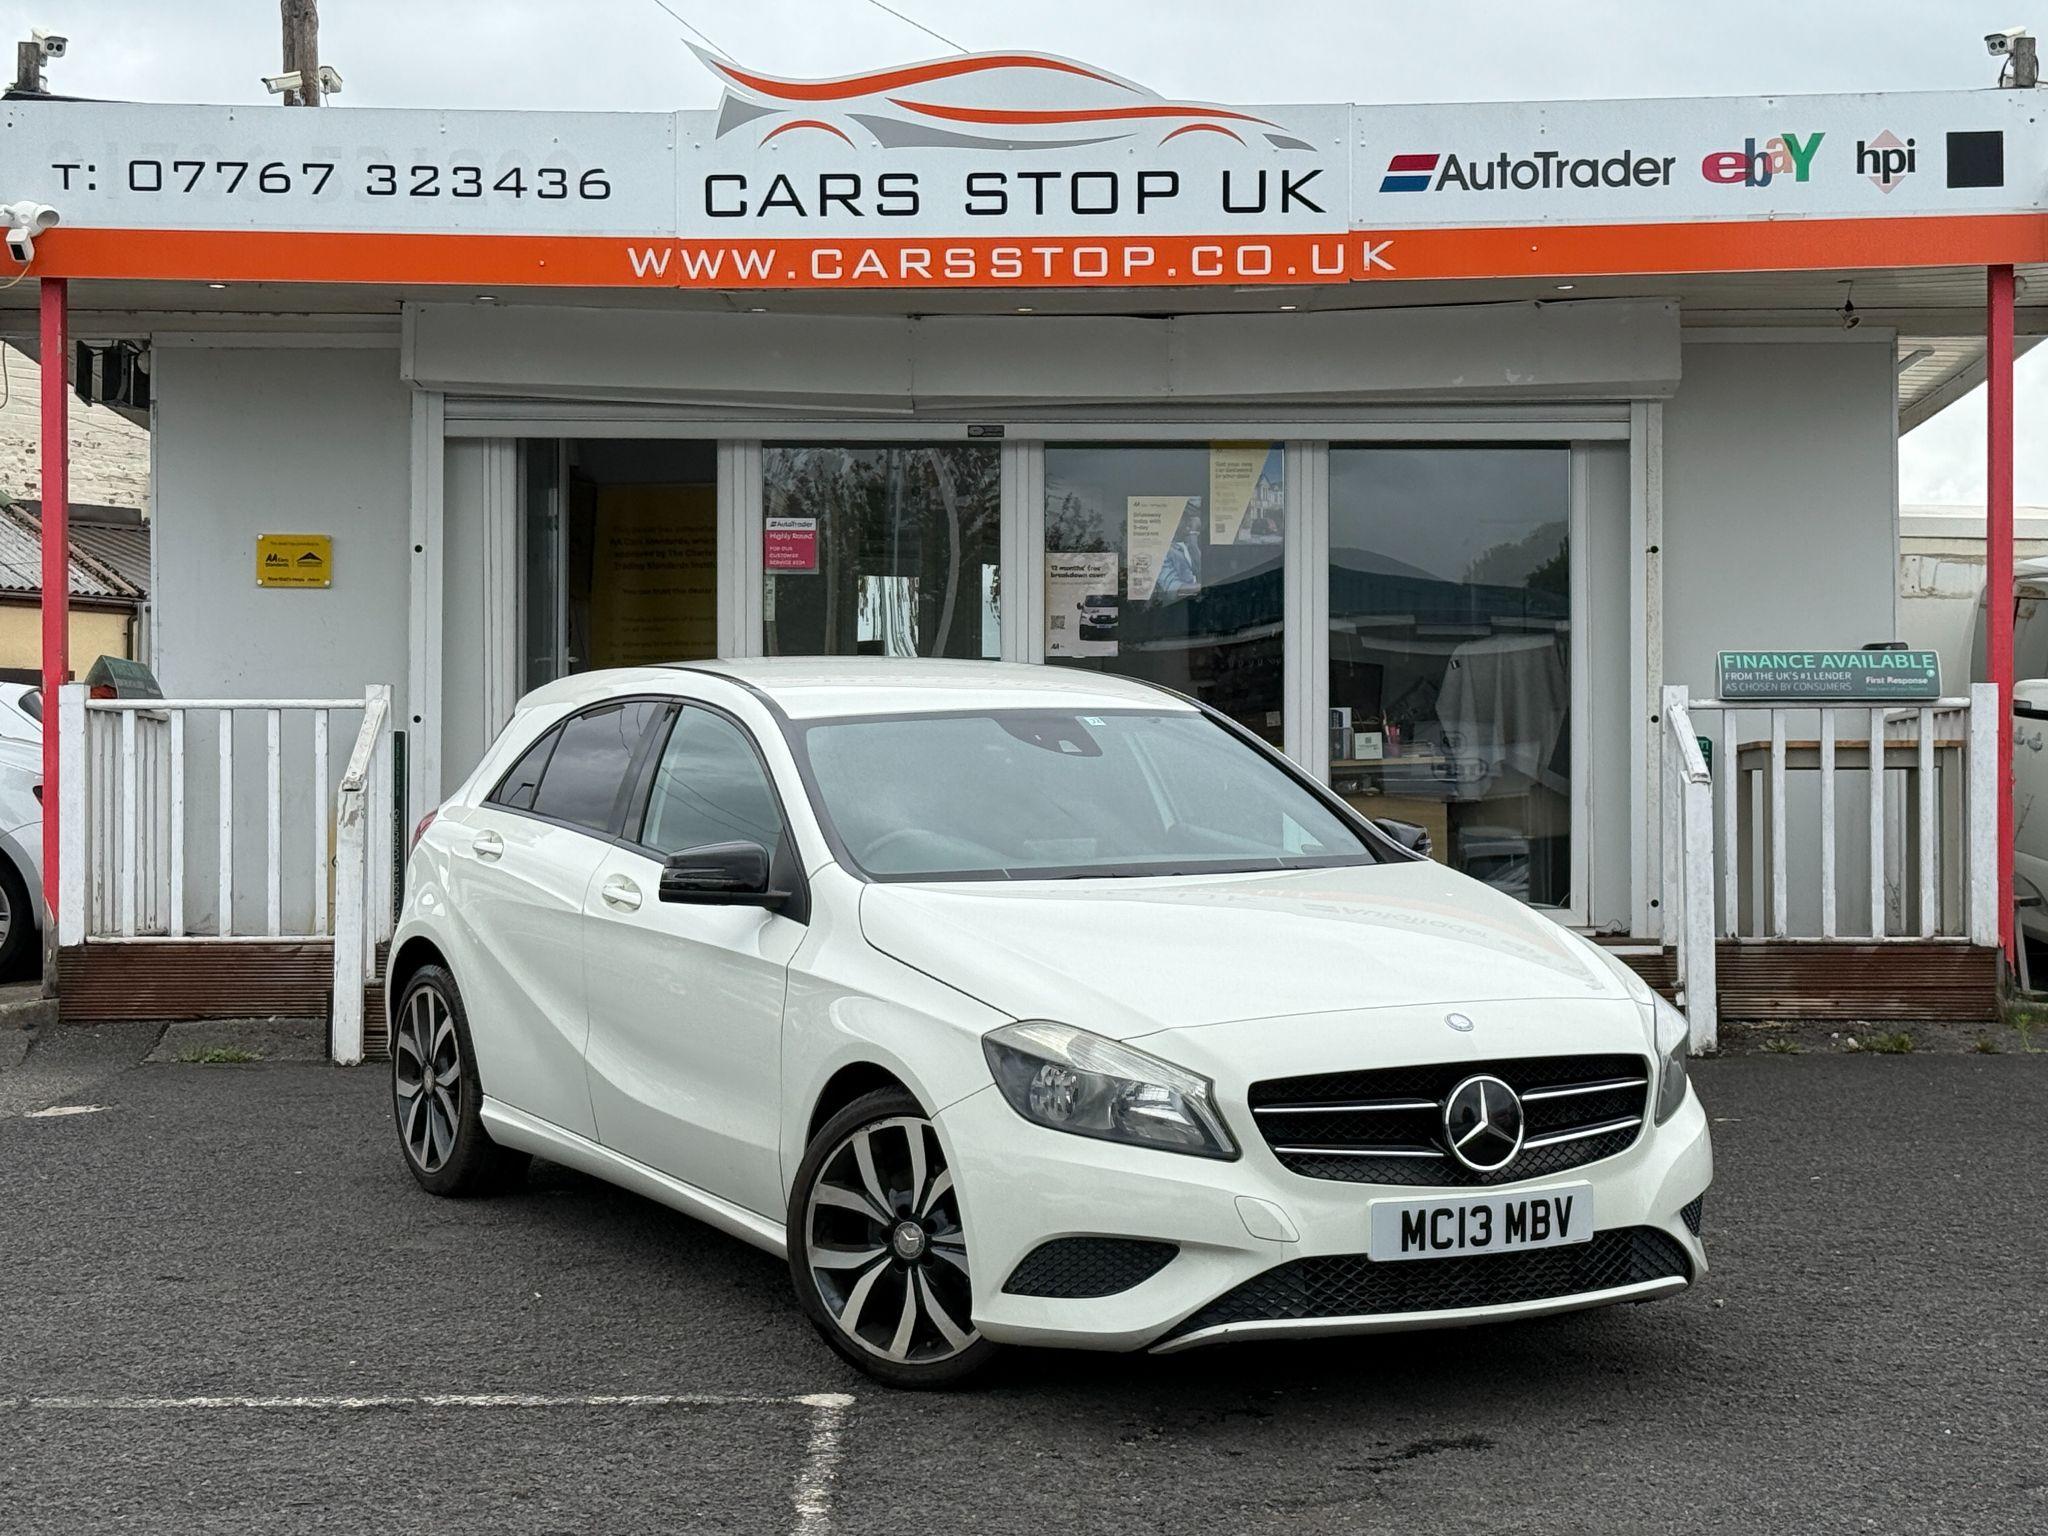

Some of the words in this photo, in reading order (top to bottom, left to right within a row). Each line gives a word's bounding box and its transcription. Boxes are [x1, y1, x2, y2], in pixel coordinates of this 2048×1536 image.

[52, 164, 96, 191] T:
[128, 160, 335, 195] 07767
[366, 164, 611, 200] 323436
[1434, 150, 1676, 192] AutoTrader
[1857, 138, 1916, 184] hpi
[705, 173, 920, 218] CARS
[964, 171, 1180, 216] STOP
[1222, 169, 1326, 214] UK
[627, 240, 1398, 279] WWW.CARSSTOP.CO.UK
[1723, 654, 1816, 669] FINANCE
[1821, 653, 1936, 669] AVAILABLE
[1725, 671, 1753, 681] FROM
[1755, 671, 1774, 681] THE
[1776, 671, 1799, 681] UK'S
[1800, 672, 1811, 681] #1
[1813, 671, 1852, 681] LENDER
[1725, 682, 1738, 691] AS
[1739, 682, 1778, 692] CHOSEN
[1780, 682, 1791, 692] BY
[1793, 681, 1852, 692] CONSUMERS
[1865, 676, 1885, 685] First
[1886, 676, 1929, 686] Response
[1401, 1205, 1493, 1252] MC13
[1505, 1195, 1574, 1244] MBV
